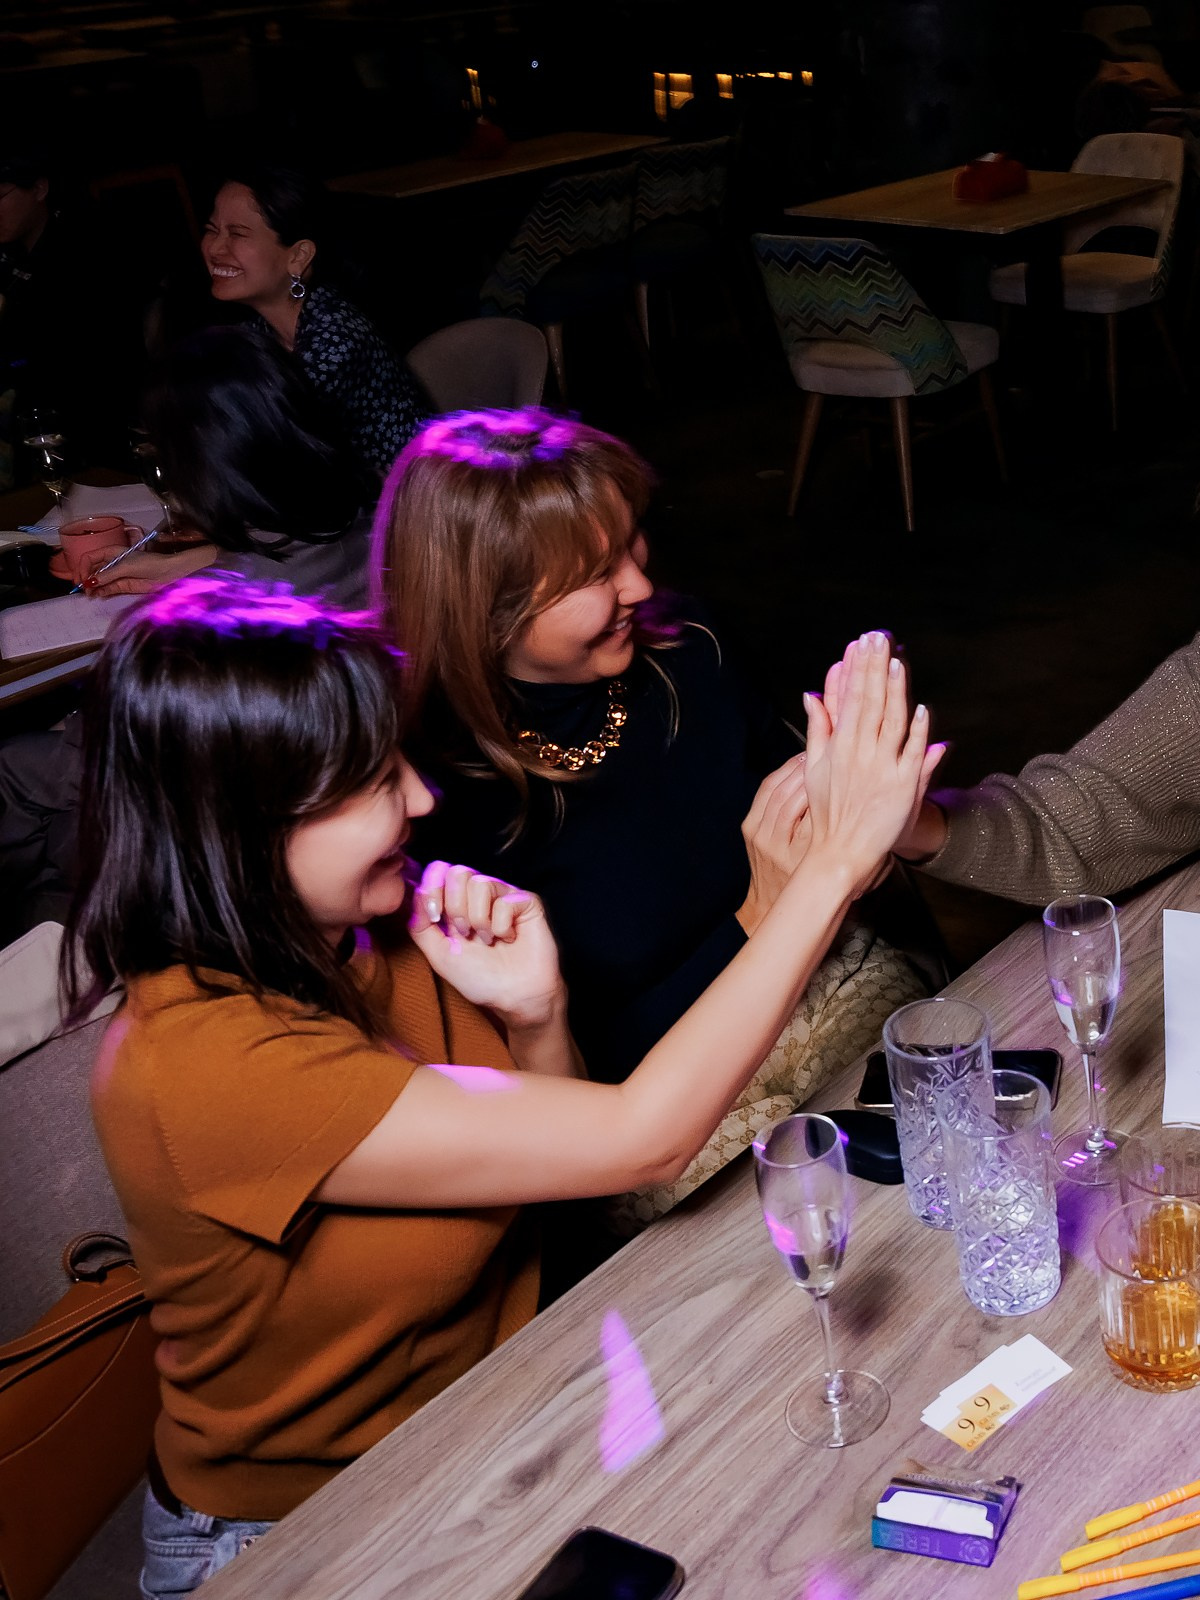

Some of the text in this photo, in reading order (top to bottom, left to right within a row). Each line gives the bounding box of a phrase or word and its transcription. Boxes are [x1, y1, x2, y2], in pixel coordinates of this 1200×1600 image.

[974, 1396, 990, 1411] 9
[958, 1418, 975, 1433] 9
[880, 1530, 942, 1555] TEREA
